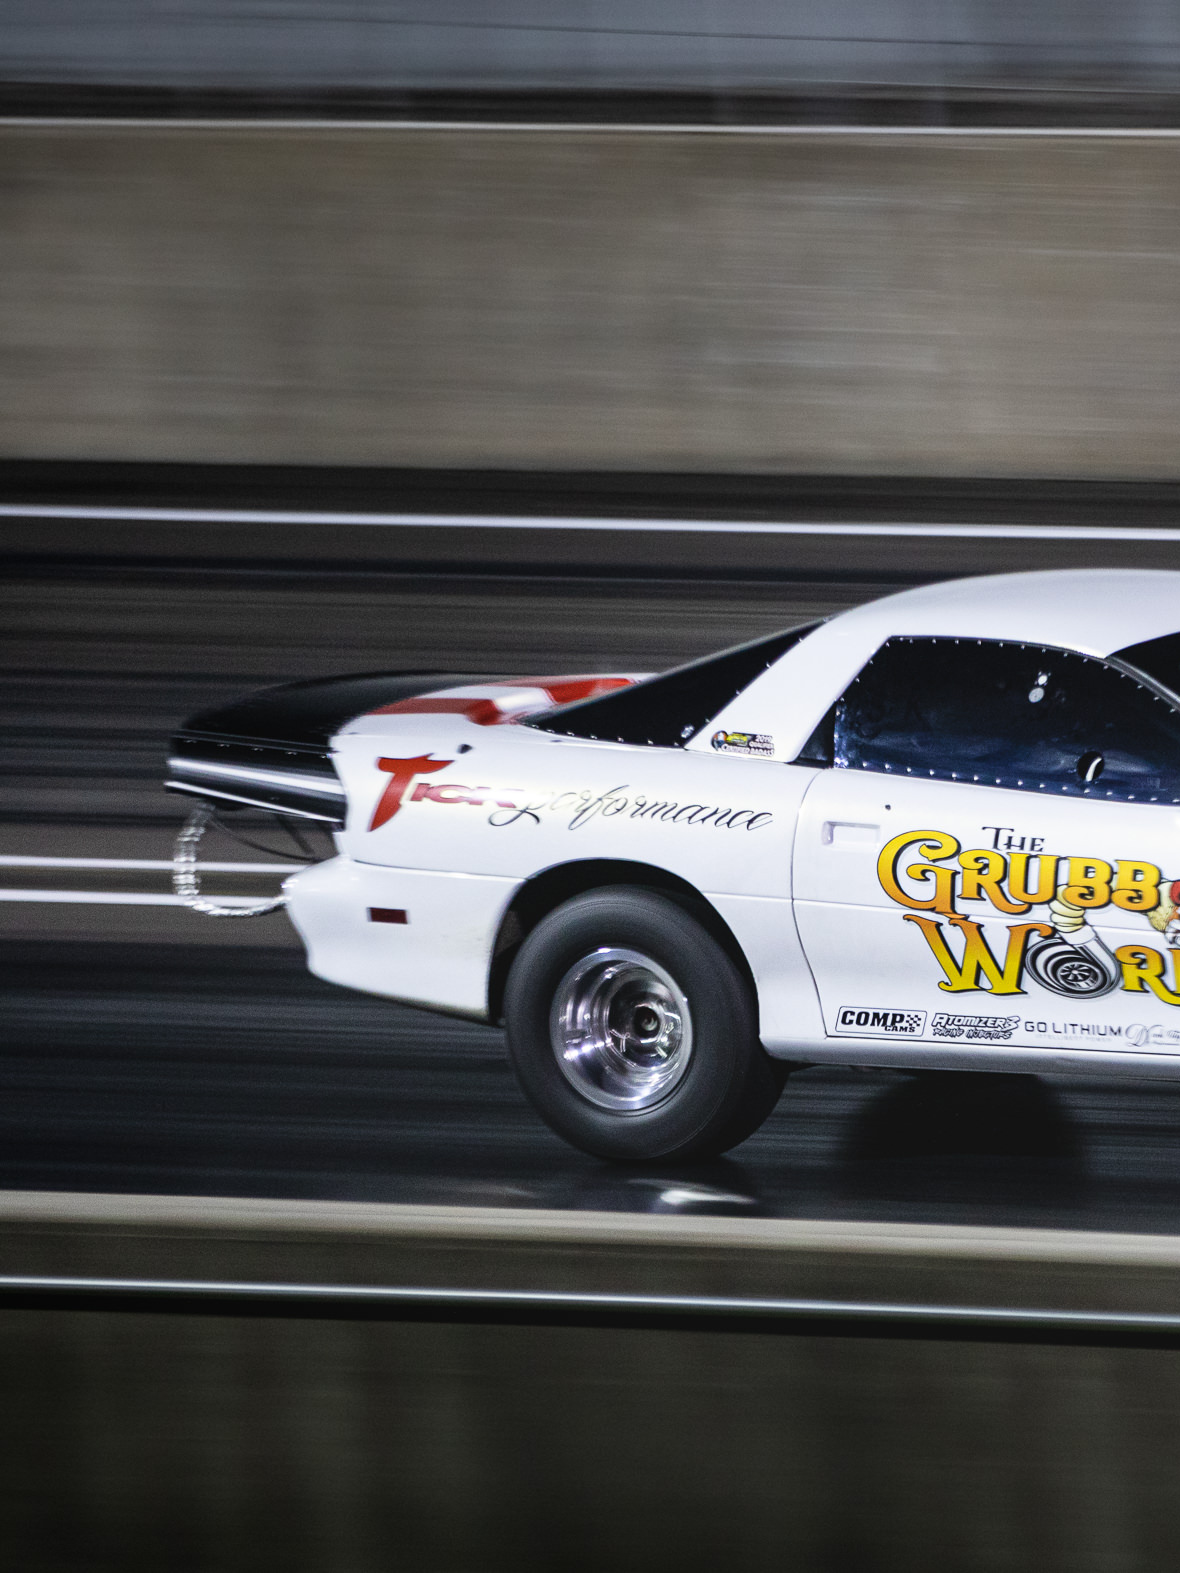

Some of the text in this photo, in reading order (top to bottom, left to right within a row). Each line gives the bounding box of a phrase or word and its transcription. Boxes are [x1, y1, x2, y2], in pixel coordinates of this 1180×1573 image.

[982, 826, 1045, 852] THE
[877, 829, 1161, 919] GRUBB
[840, 1009, 906, 1028] COMP
[884, 1025, 916, 1034] CAMS
[1024, 1021, 1048, 1033] GO
[1052, 1022, 1122, 1037] LITHIUM
